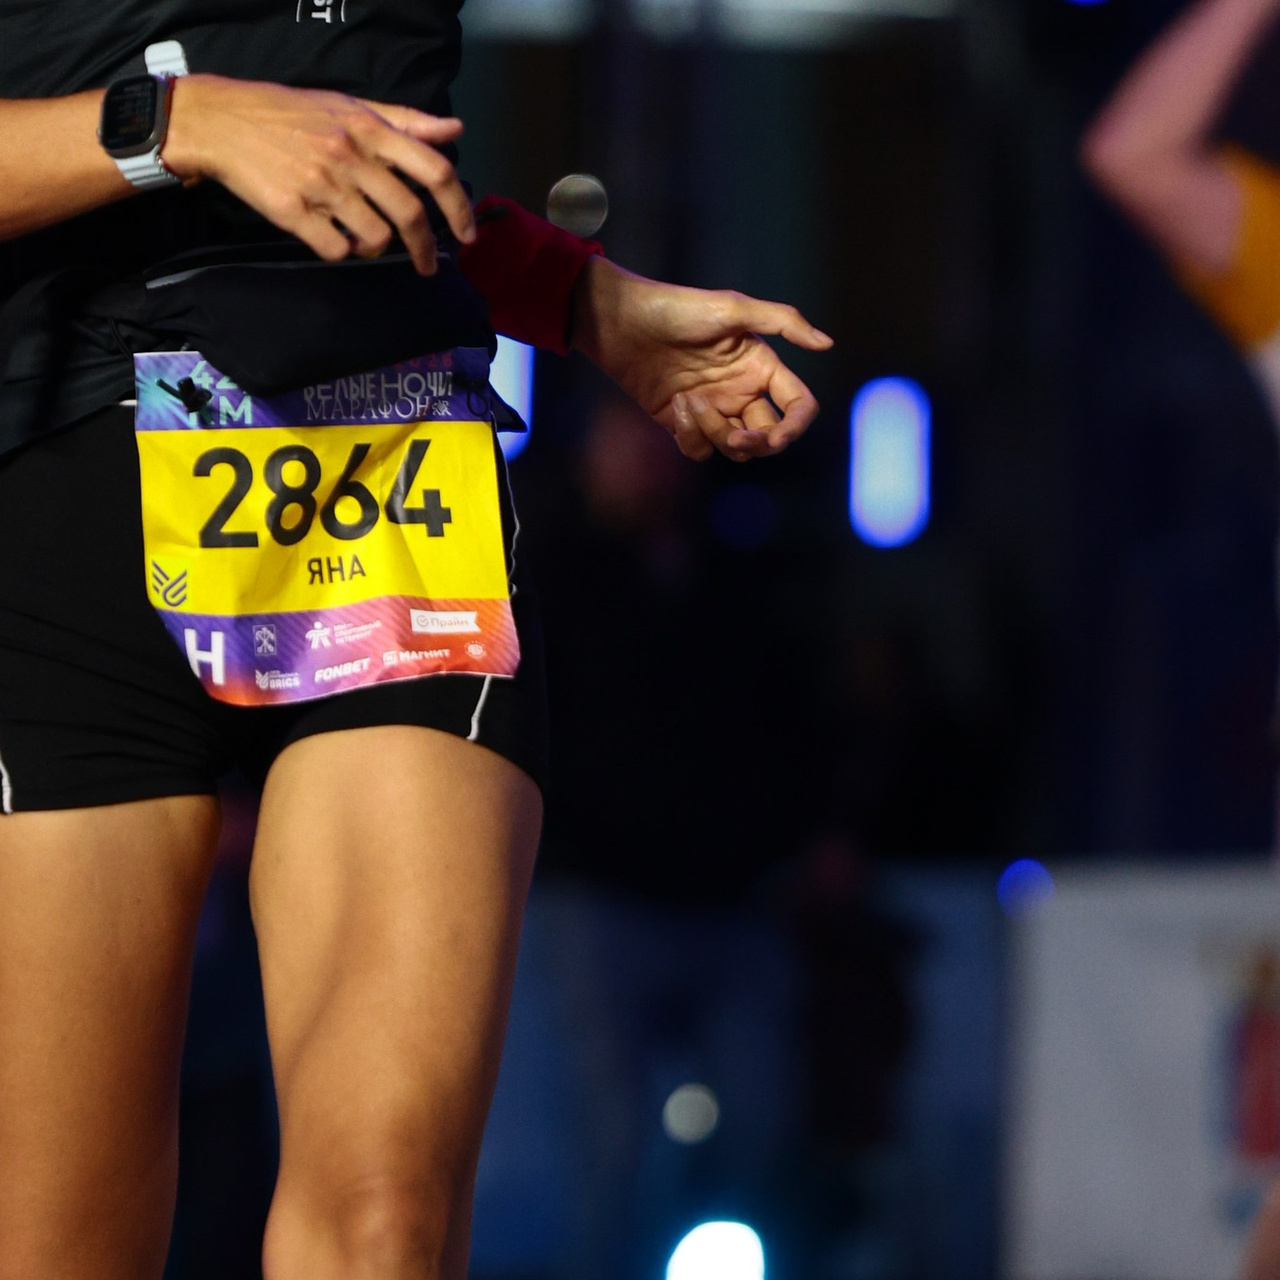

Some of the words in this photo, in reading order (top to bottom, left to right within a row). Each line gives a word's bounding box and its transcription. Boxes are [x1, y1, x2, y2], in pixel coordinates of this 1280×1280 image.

[306, 396, 429, 419] МАРАФОН
[193, 438, 452, 548] 2864
[307, 554, 366, 585] ЯНА
[431, 617, 469, 628] Прайм
[399, 648, 451, 661] МАГНИТ
[315, 658, 371, 683] FONBET
